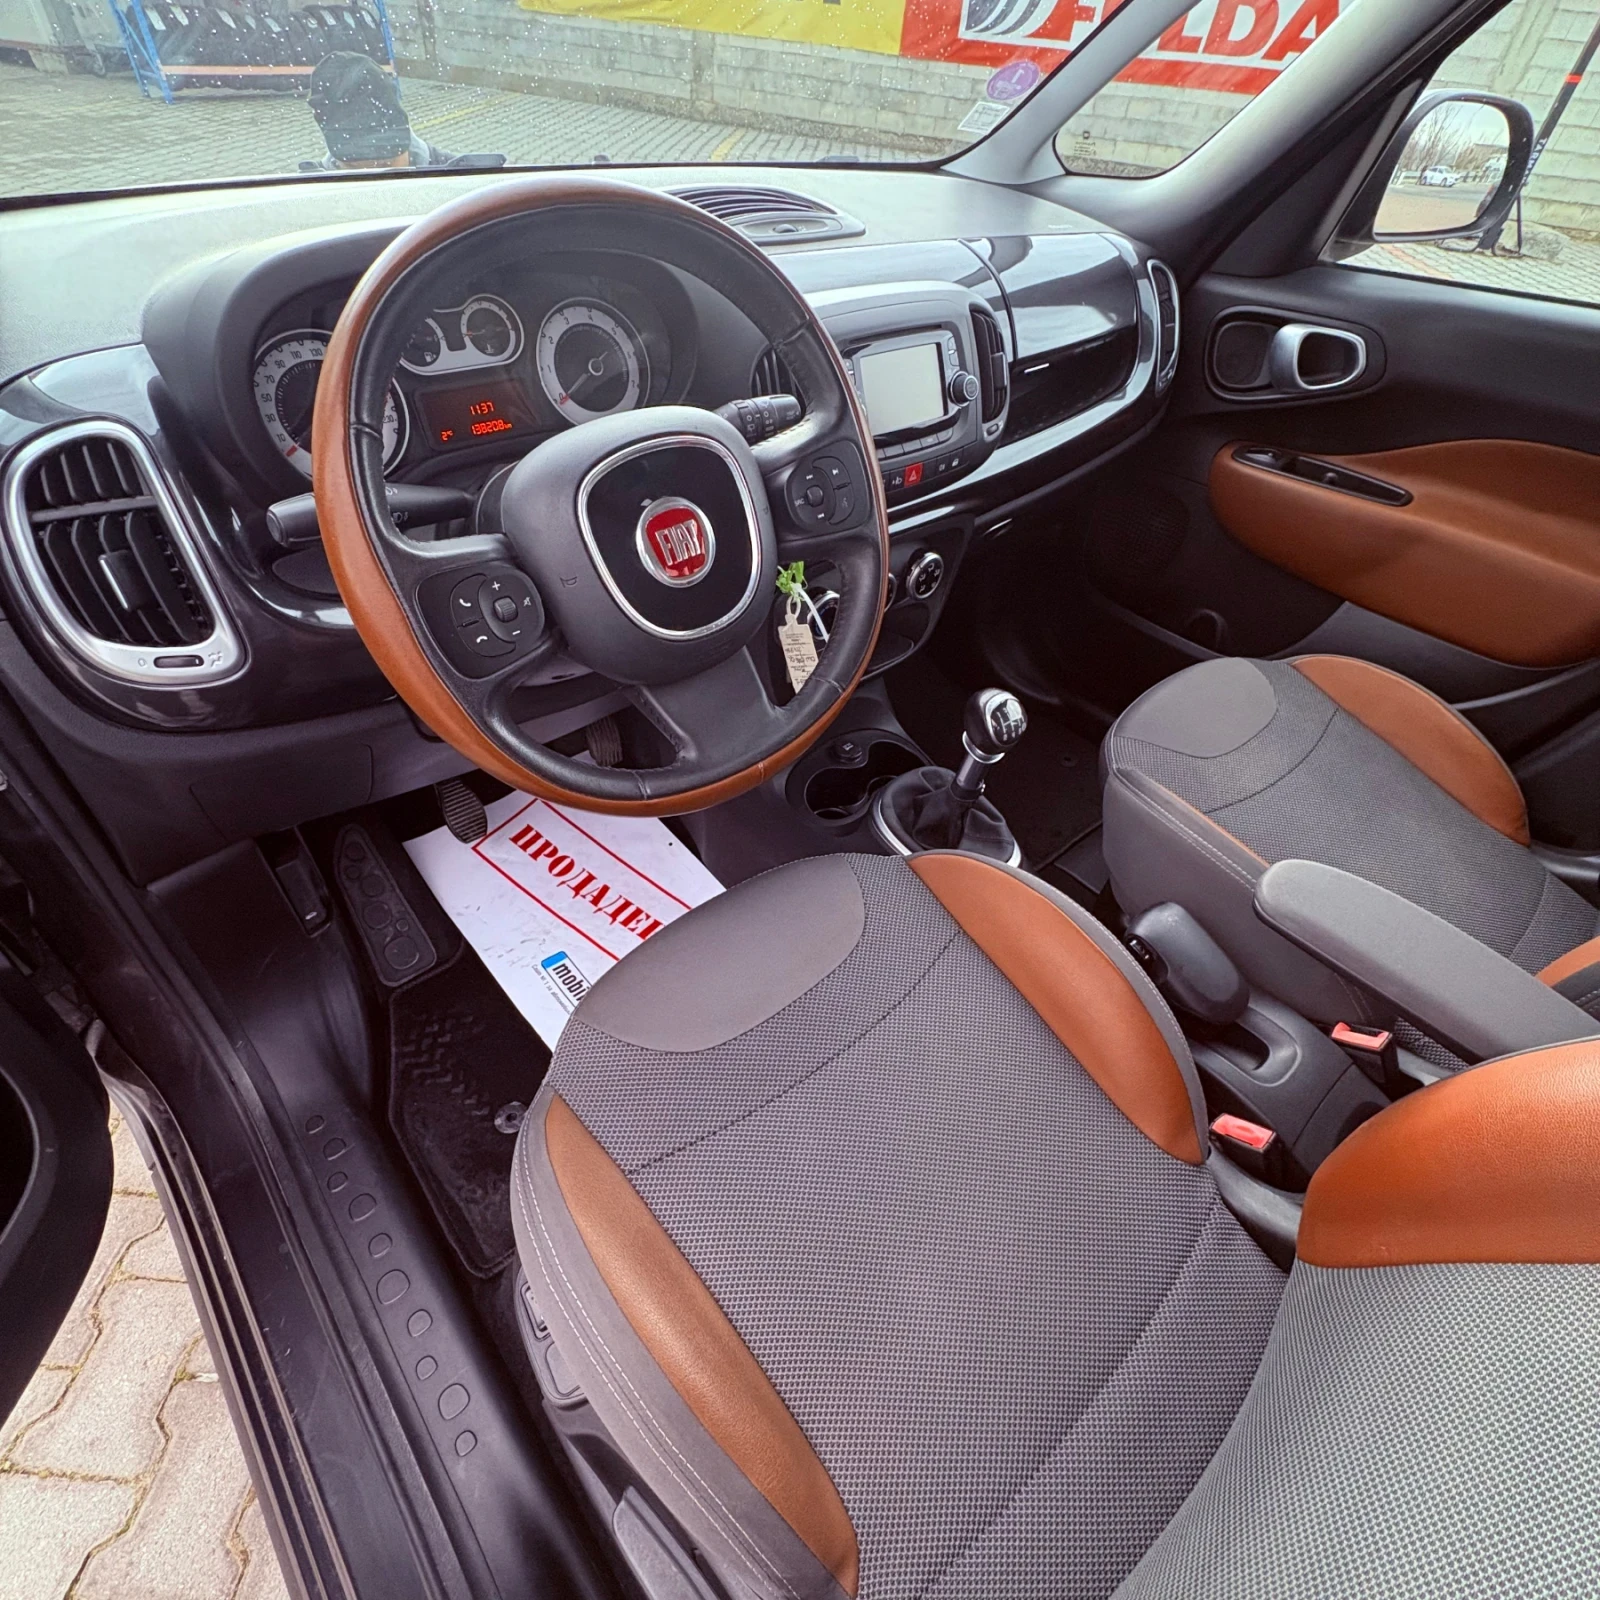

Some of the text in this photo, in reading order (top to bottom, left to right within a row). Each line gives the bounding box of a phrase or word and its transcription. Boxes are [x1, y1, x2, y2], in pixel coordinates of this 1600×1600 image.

[1022, 0, 1340, 62] FLDA
[290, 350, 303, 359] 110
[310, 348, 323, 356] 130
[274, 360, 287, 370] 90
[264, 374, 276, 384] 70
[261, 393, 273, 403] 50
[265, 412, 277, 423] 30
[276, 433, 287, 443] 10
[654, 519, 702, 566] FIAT
